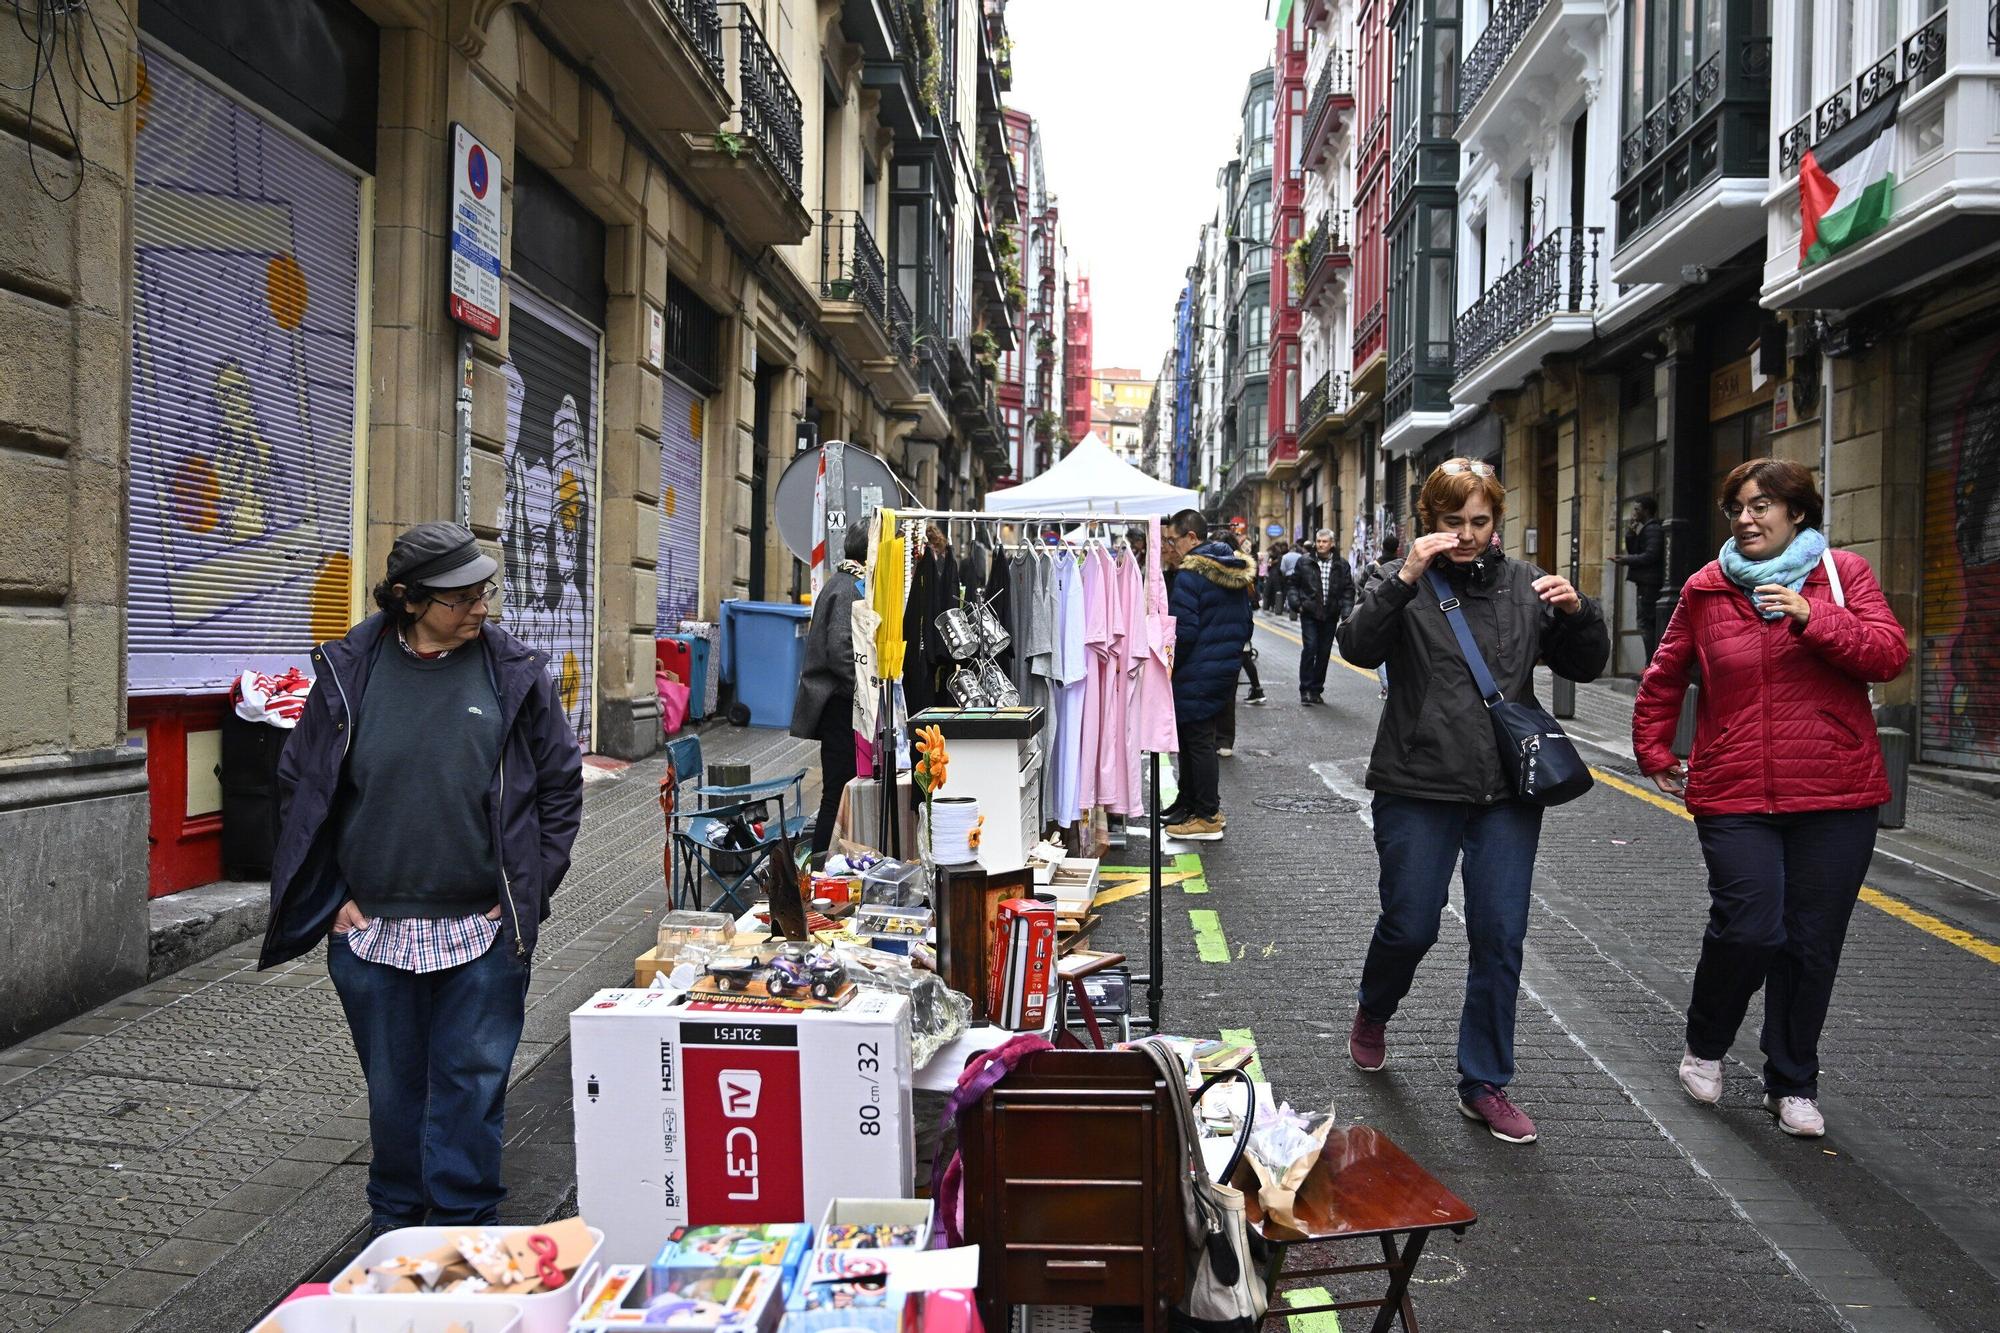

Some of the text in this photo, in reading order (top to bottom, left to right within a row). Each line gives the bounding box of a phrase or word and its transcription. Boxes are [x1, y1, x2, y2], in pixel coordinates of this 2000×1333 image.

[714, 1028, 762, 1041] 32LF51
[661, 1042, 672, 1092] HDMI
[665, 1135, 673, 1153] USB
[726, 1081, 759, 1200] LED TV
